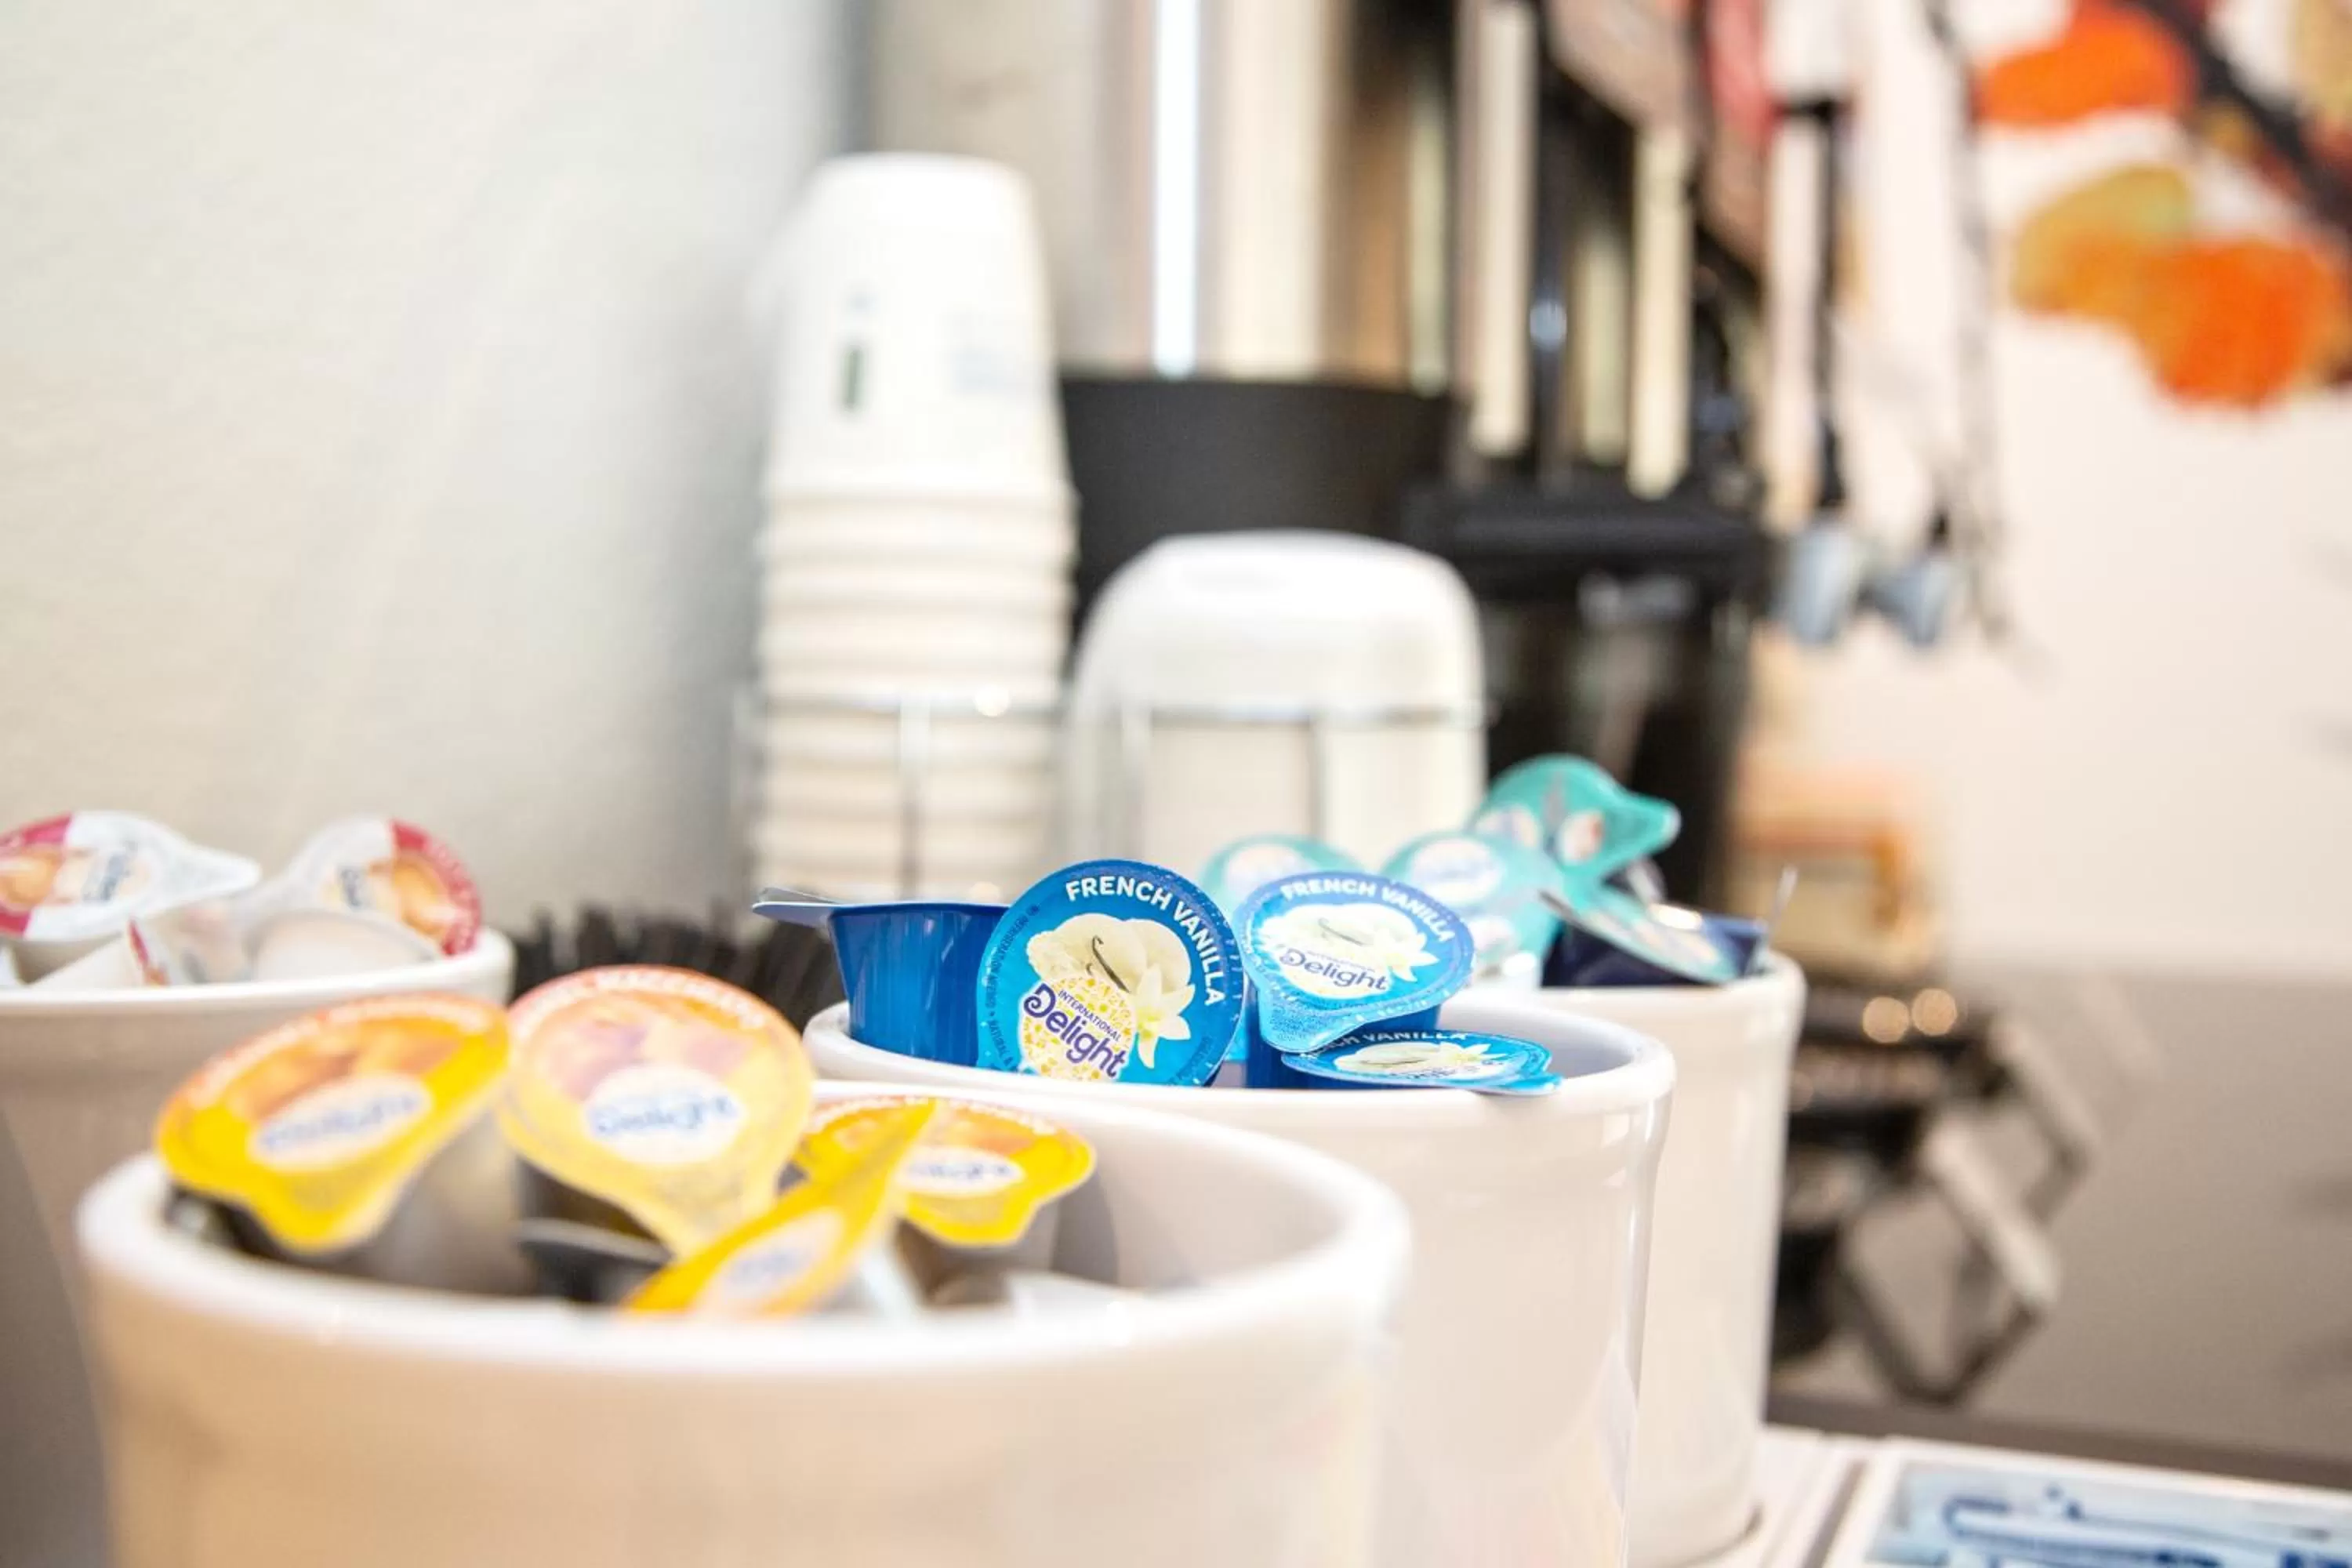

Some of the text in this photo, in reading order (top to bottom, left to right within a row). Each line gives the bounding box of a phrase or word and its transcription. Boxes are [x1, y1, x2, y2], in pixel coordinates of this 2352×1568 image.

[1065, 876, 1226, 1006] FRENCH VANILLA
[1280, 878, 1456, 942] FRENCH VANILLA
[1279, 948, 1387, 989] Delight
[1023, 983, 1127, 1077] Delight
[1058, 989, 1121, 1042] INTERNATIONAL
